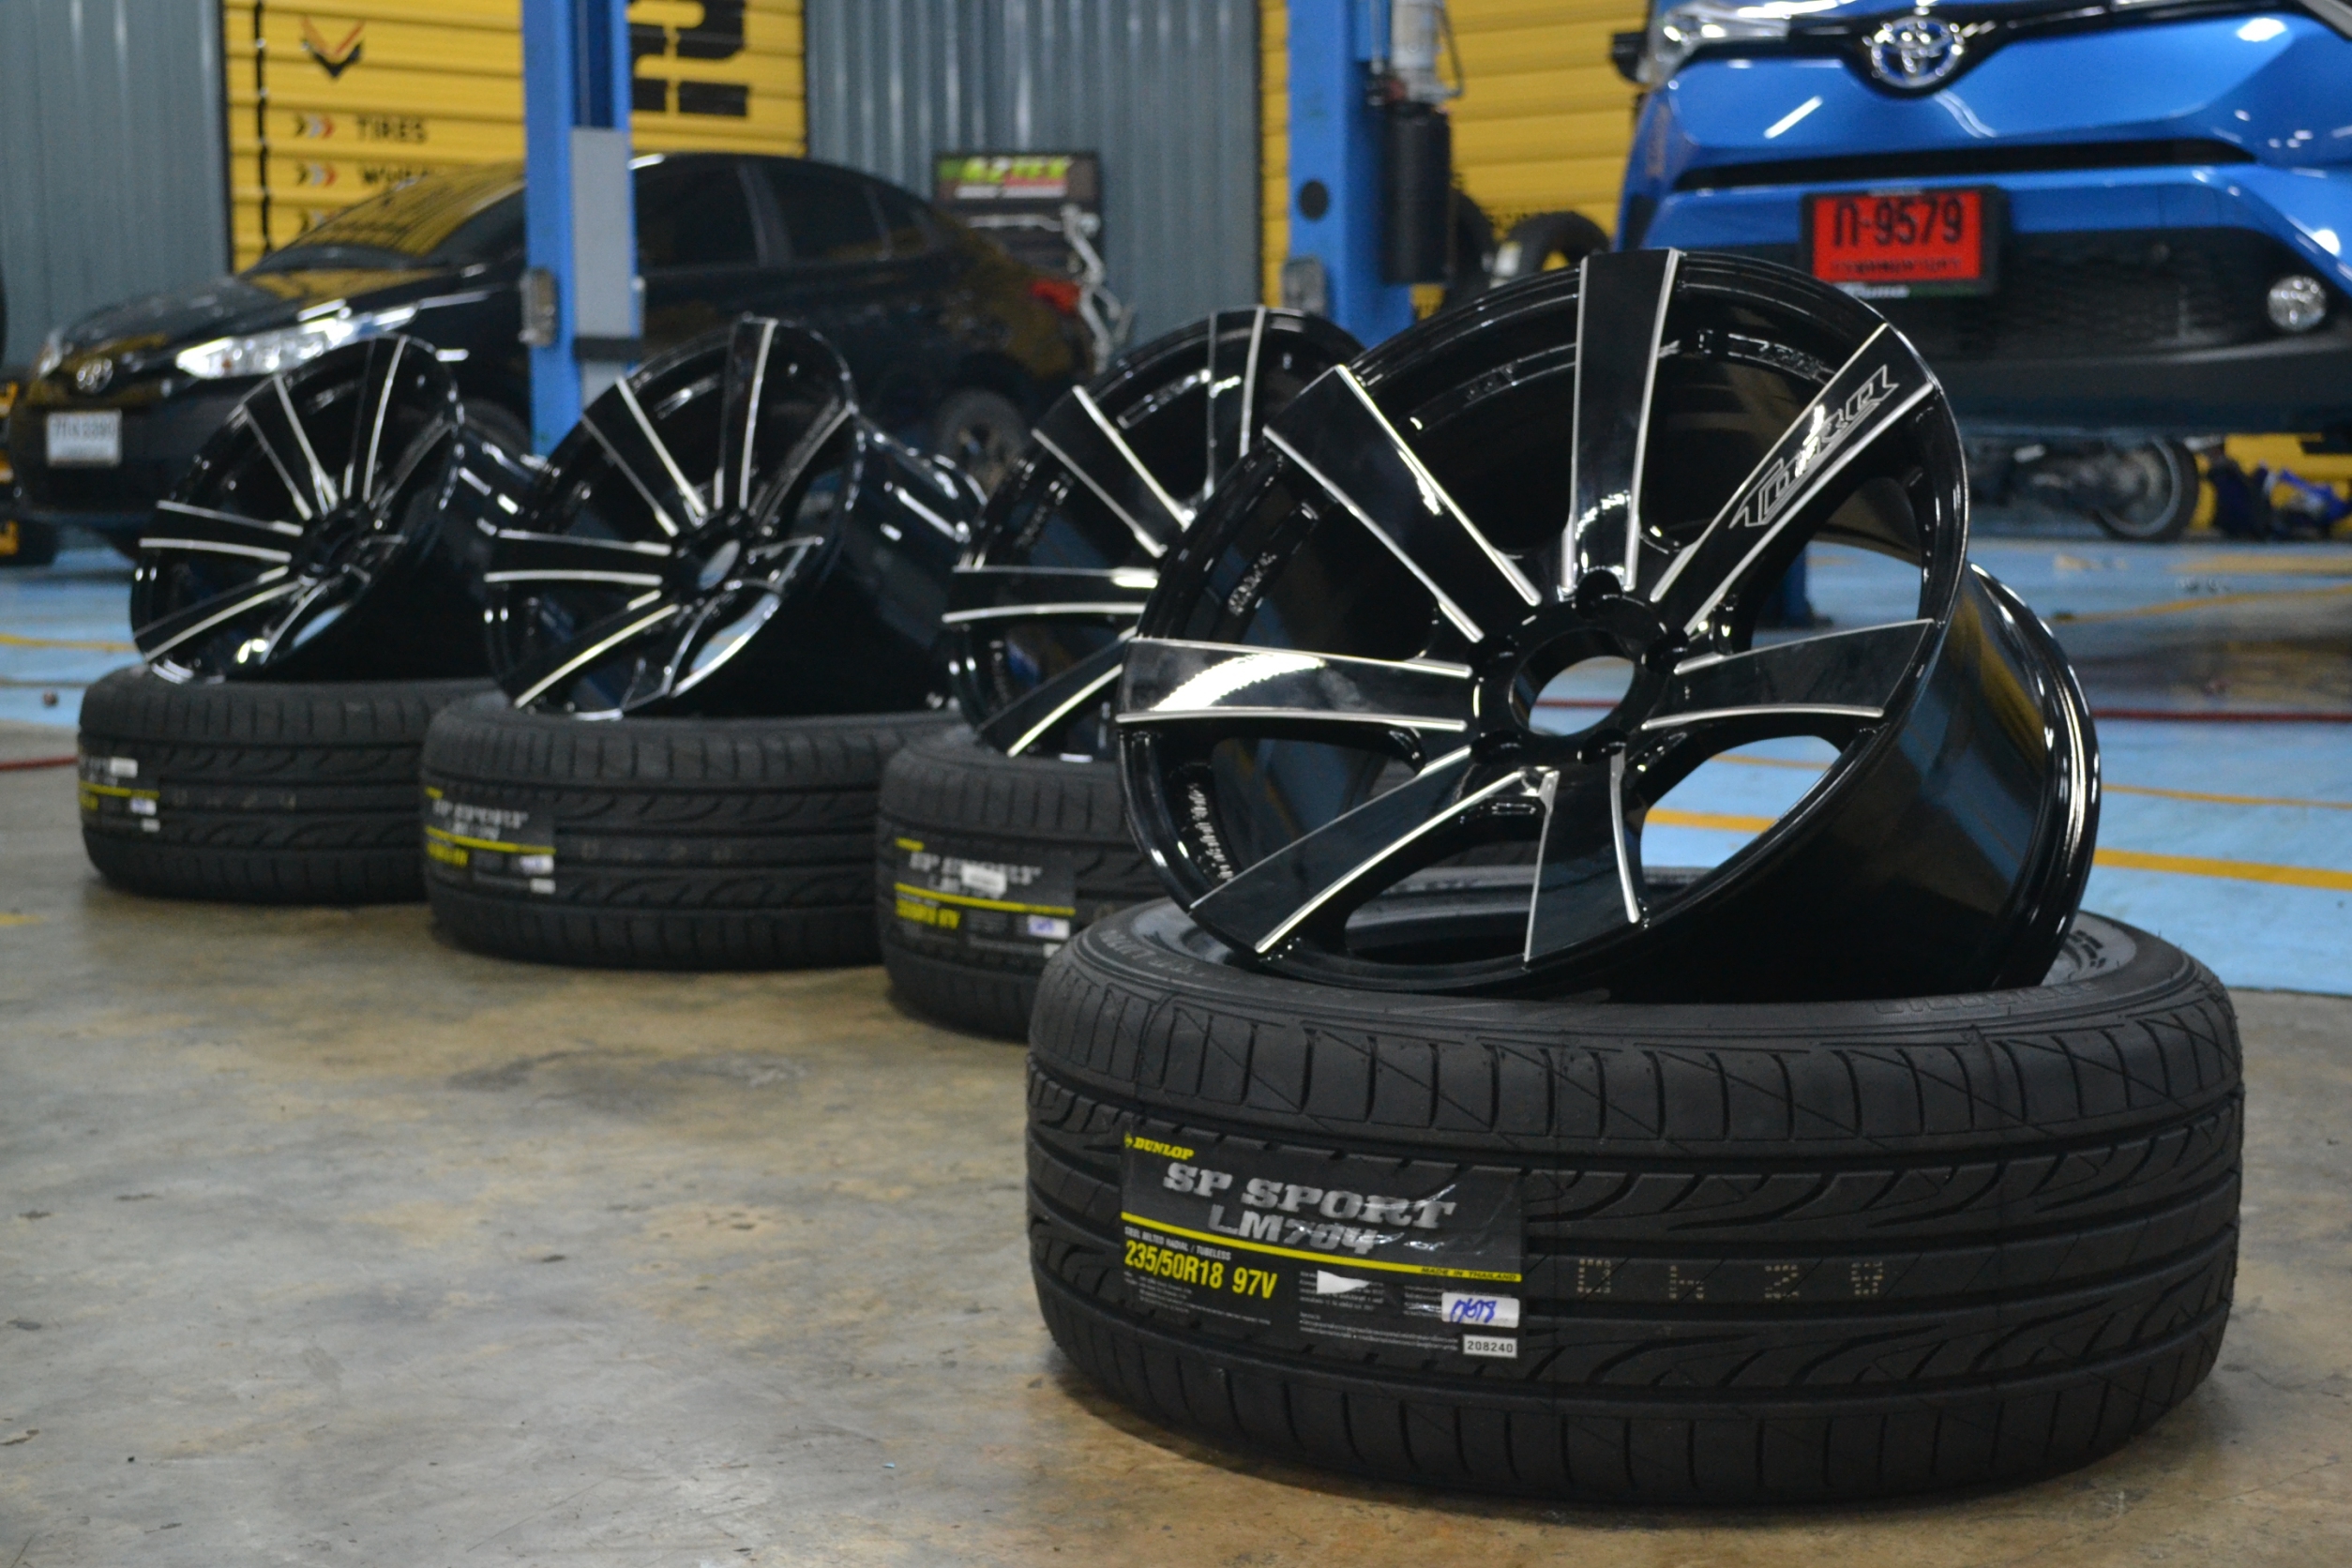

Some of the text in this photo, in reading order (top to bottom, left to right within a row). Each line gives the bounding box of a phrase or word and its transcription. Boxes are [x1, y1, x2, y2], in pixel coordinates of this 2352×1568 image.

[356, 114, 428, 144] TIRES
[1132, 1136, 1196, 1161] DUNLOP
[1163, 1162, 1457, 1229] SP SPORT
[1208, 1204, 1380, 1256] LM704
[1166, 1238, 1189, 1252] RADIAL
[1196, 1244, 1232, 1261] TUBELESS
[1124, 1239, 1226, 1289] 235/50R18
[1231, 1266, 1278, 1300] 97V
[1421, 1266, 1448, 1276] MADE
[1469, 1270, 1518, 1281] THAILAND
[1467, 1339, 1515, 1355] 208240
